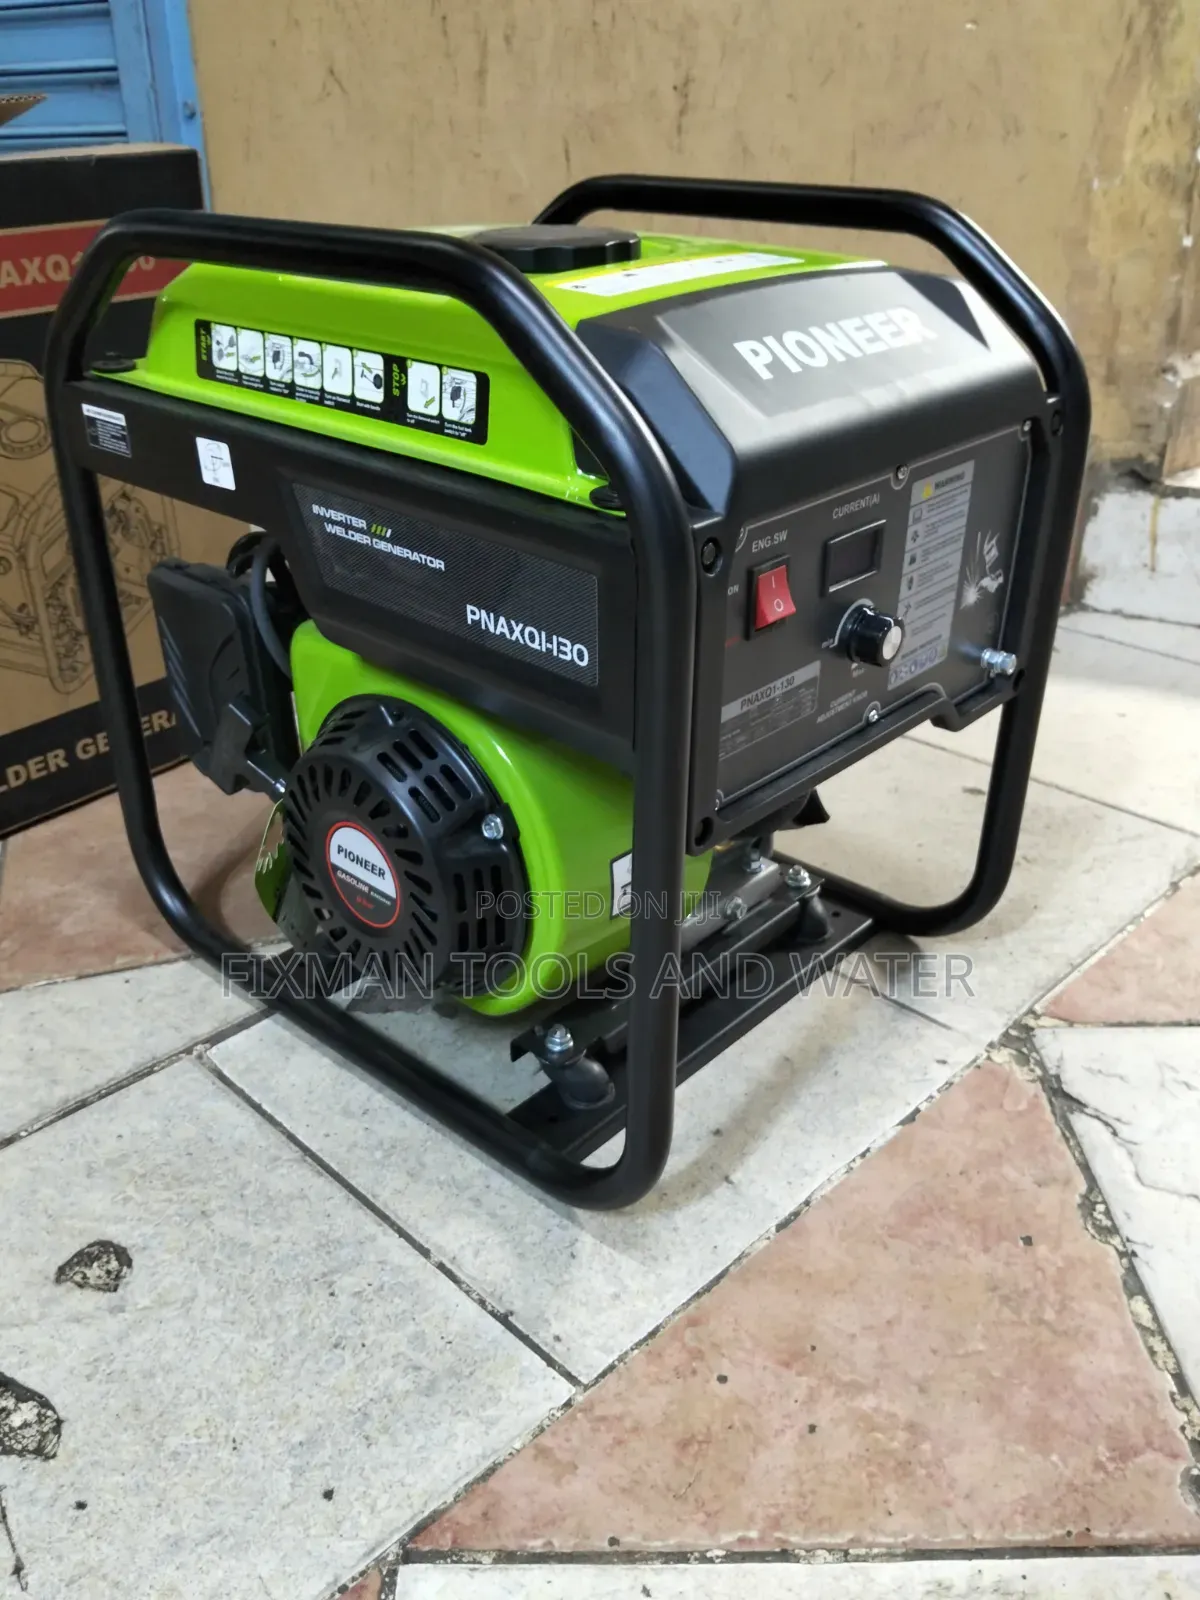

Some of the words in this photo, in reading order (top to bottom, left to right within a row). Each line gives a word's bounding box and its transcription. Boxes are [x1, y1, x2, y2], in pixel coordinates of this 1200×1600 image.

[733, 306, 939, 381] PIONEER
[391, 363, 401, 397] STOP
[312, 504, 367, 530] INVERTER
[832, 493, 880, 519] CURRENT(A)
[324, 522, 371, 547] WELDER
[372, 537, 446, 571] GENERATOR
[751, 529, 788, 553] ENG.SW
[727, 584, 739, 595] ON
[740, 675, 796, 711] PNAXQ1-130
[336, 844, 387, 881] PIONEER
[336, 869, 370, 895] GASOLINE
